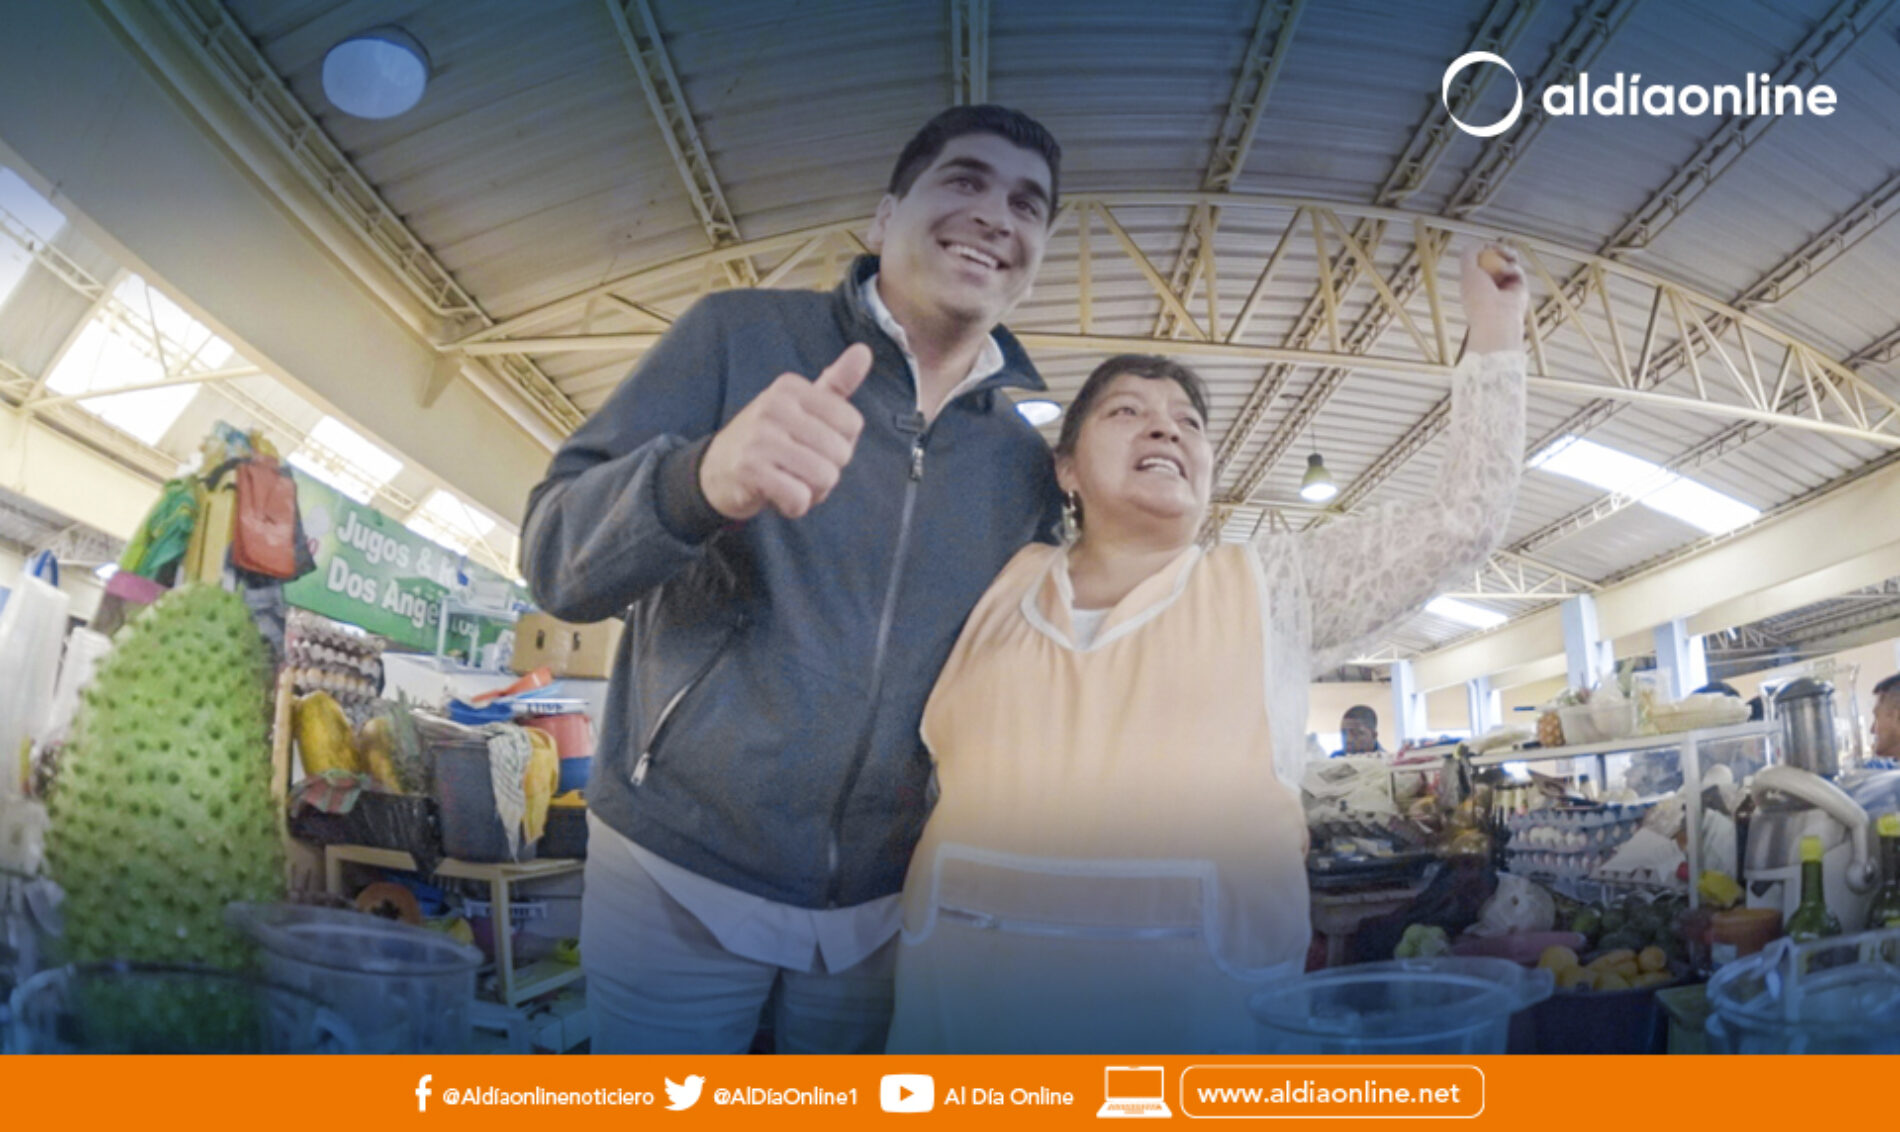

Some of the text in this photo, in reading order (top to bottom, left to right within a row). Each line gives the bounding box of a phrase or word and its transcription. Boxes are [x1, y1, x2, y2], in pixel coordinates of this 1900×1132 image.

[337, 510, 410, 567] Jugos
[416, 546, 434, 578] &
[327, 555, 377, 604] Dos
